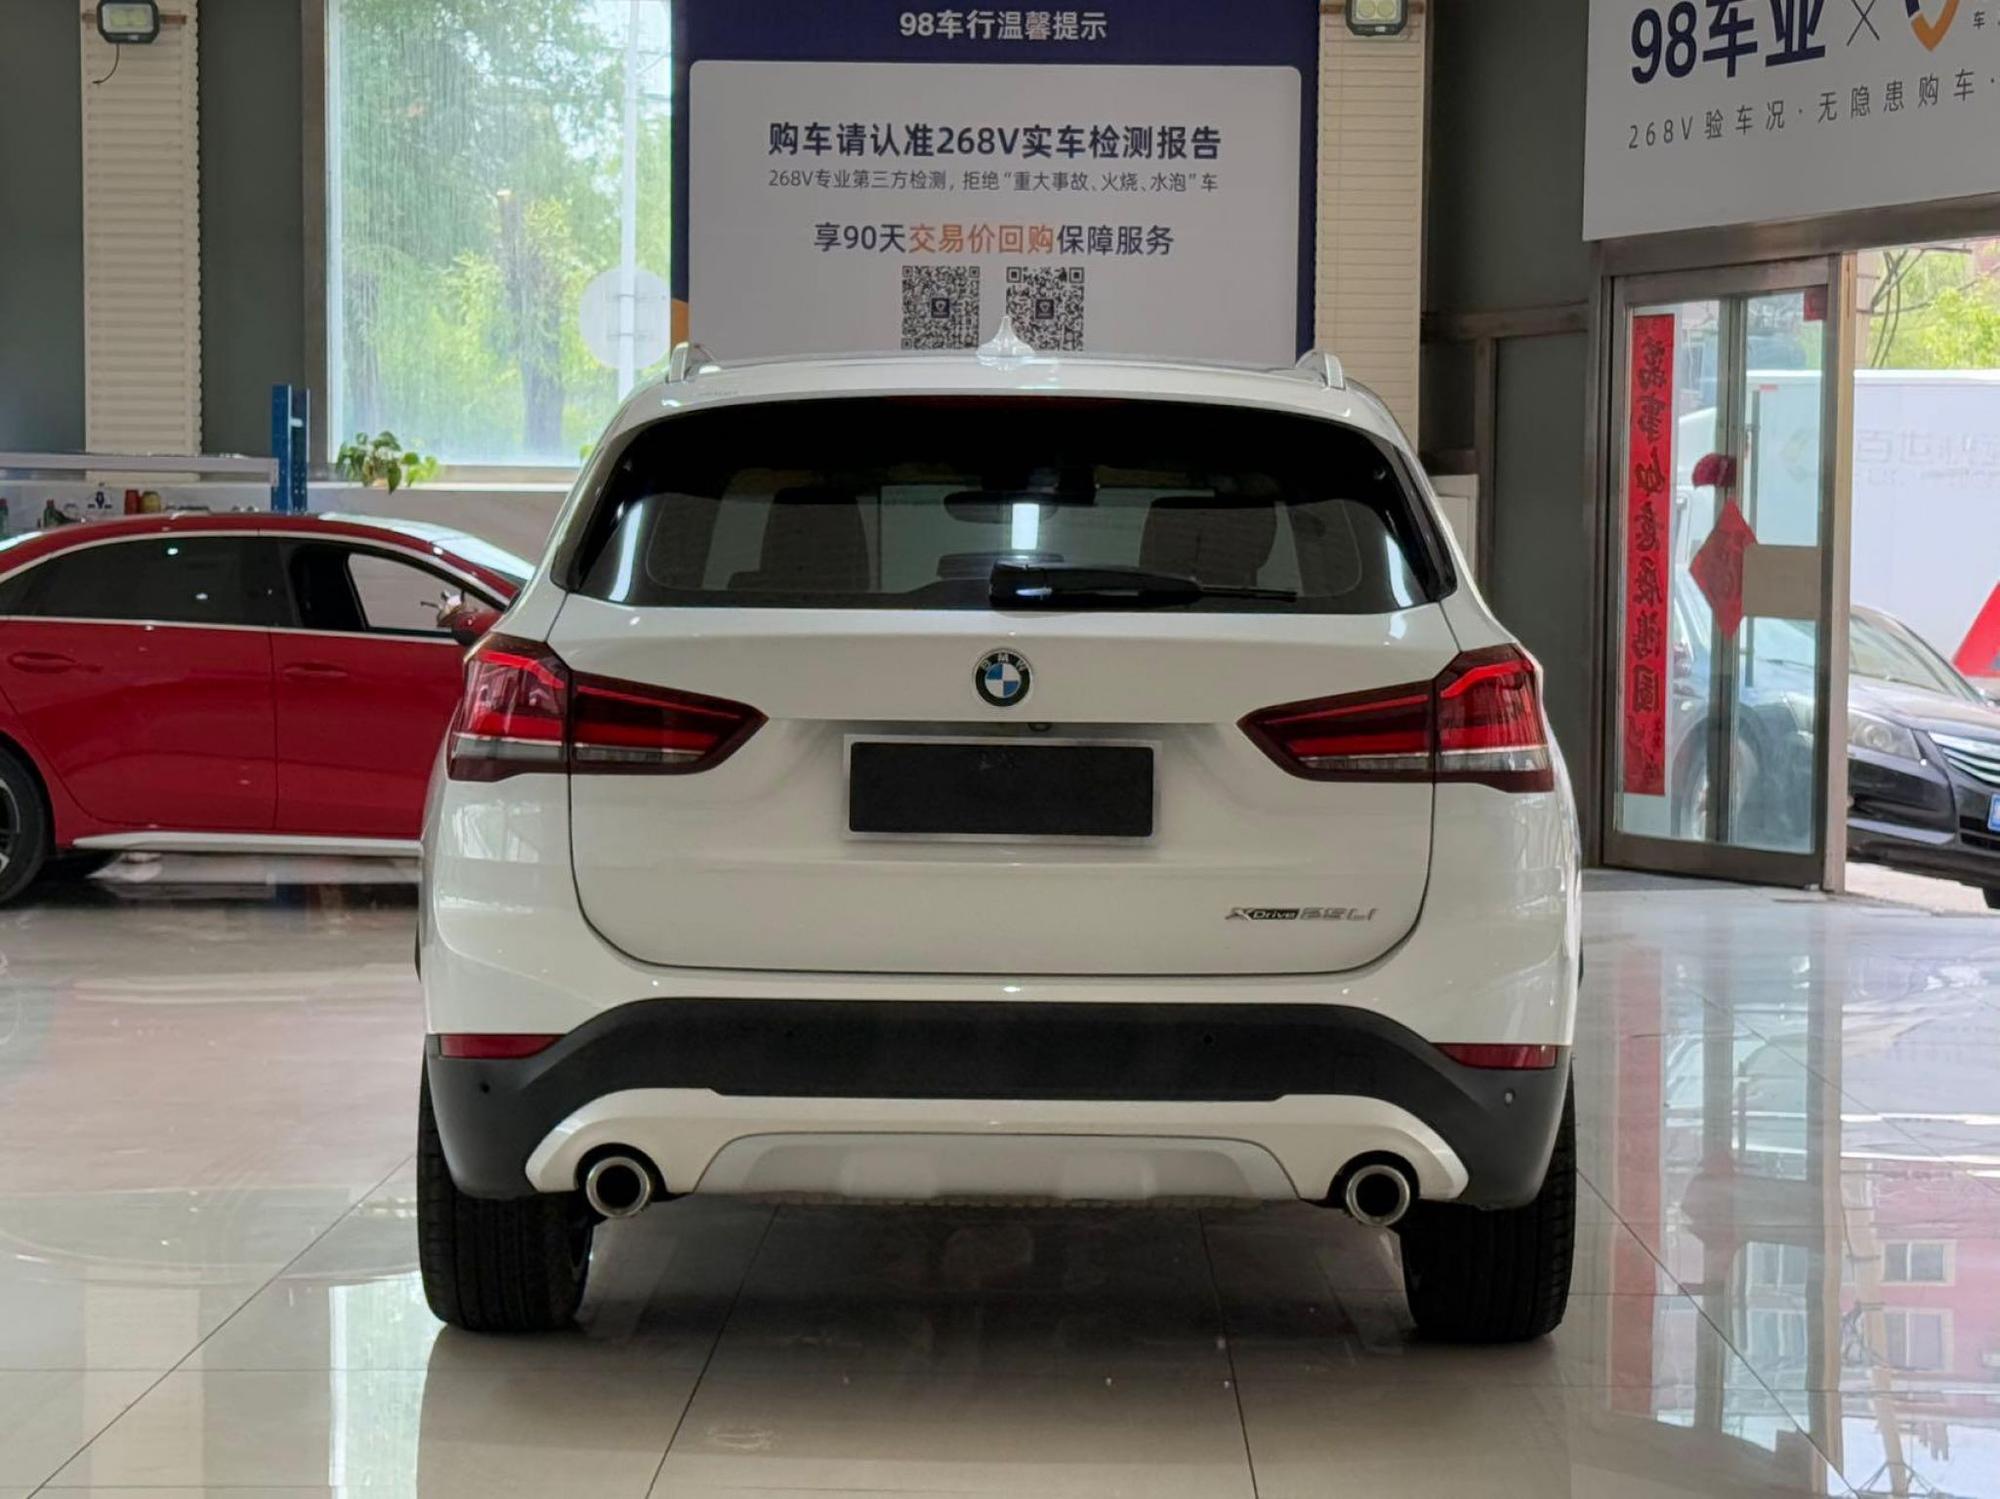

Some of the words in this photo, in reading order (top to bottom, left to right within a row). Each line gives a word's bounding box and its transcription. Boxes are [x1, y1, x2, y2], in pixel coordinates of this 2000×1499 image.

[900, 9, 1107, 41] 98车行温馨提示
[1631, 0, 1826, 84] 98车业
[768, 122, 1222, 160] 购车请认准268V实车检测报告
[813, 222, 1175, 257] 享90天交易价回购保障服务
